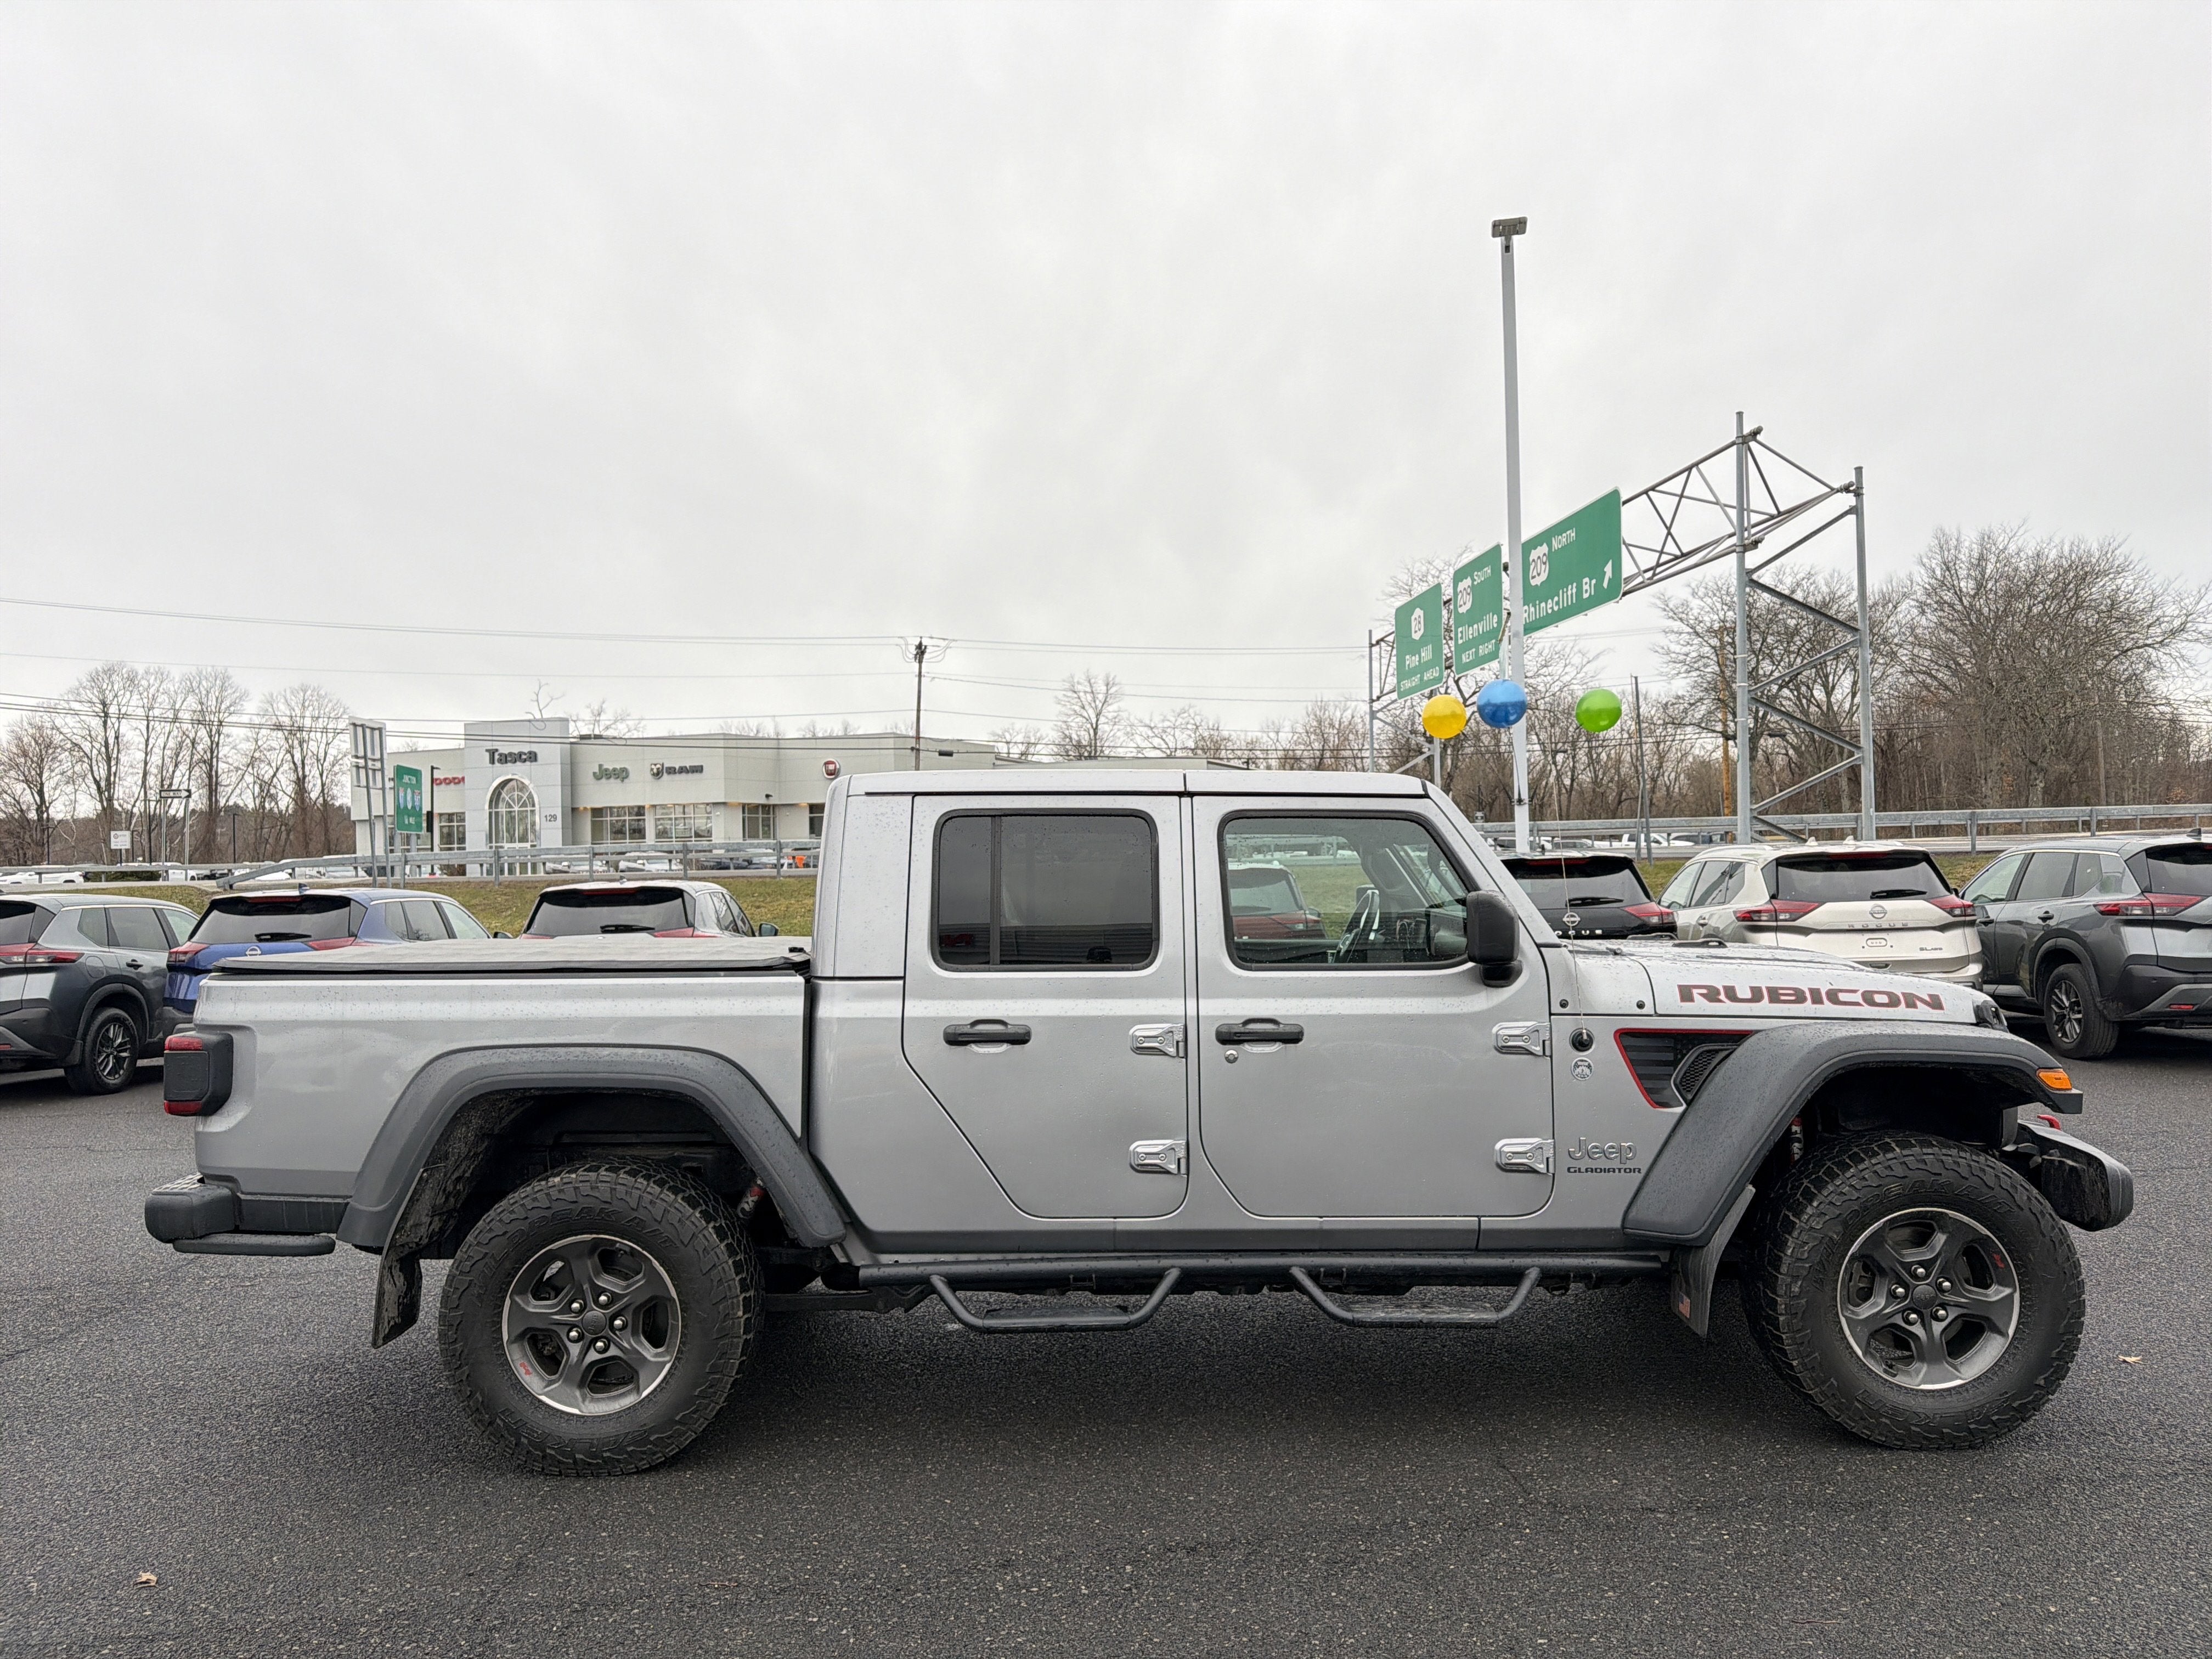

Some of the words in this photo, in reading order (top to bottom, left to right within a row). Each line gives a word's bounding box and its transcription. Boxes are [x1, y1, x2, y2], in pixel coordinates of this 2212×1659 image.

[1552, 527, 1576, 552] NORTH
[1474, 565, 1491, 585] SOUTH
[1531, 552, 1547, 580] 209
[1459, 585, 1470, 608] 209
[1523, 582, 1577, 624] Rhinecliff
[1583, 577, 1596, 599] Br
[1413, 614, 1421, 634] 28
[1458, 612, 1498, 644] Ellenville
[1406, 653, 1419, 670] Pine
[1421, 644, 1432, 663] Hill
[1462, 648, 1476, 663] NEXT
[1479, 639, 1496, 657] RIGHT
[1400, 674, 1421, 691] STRAIGHT
[1424, 666, 1440, 682] AHEAD
[485, 748, 538, 765] Tasca
[592, 763, 630, 783] Jeep
[665, 764, 704, 775] RAM
[1677, 984, 1945, 1011] RUBICON
[1568, 1137, 1637, 1164] Jeep
[622, 1215, 680, 1248] A/T
